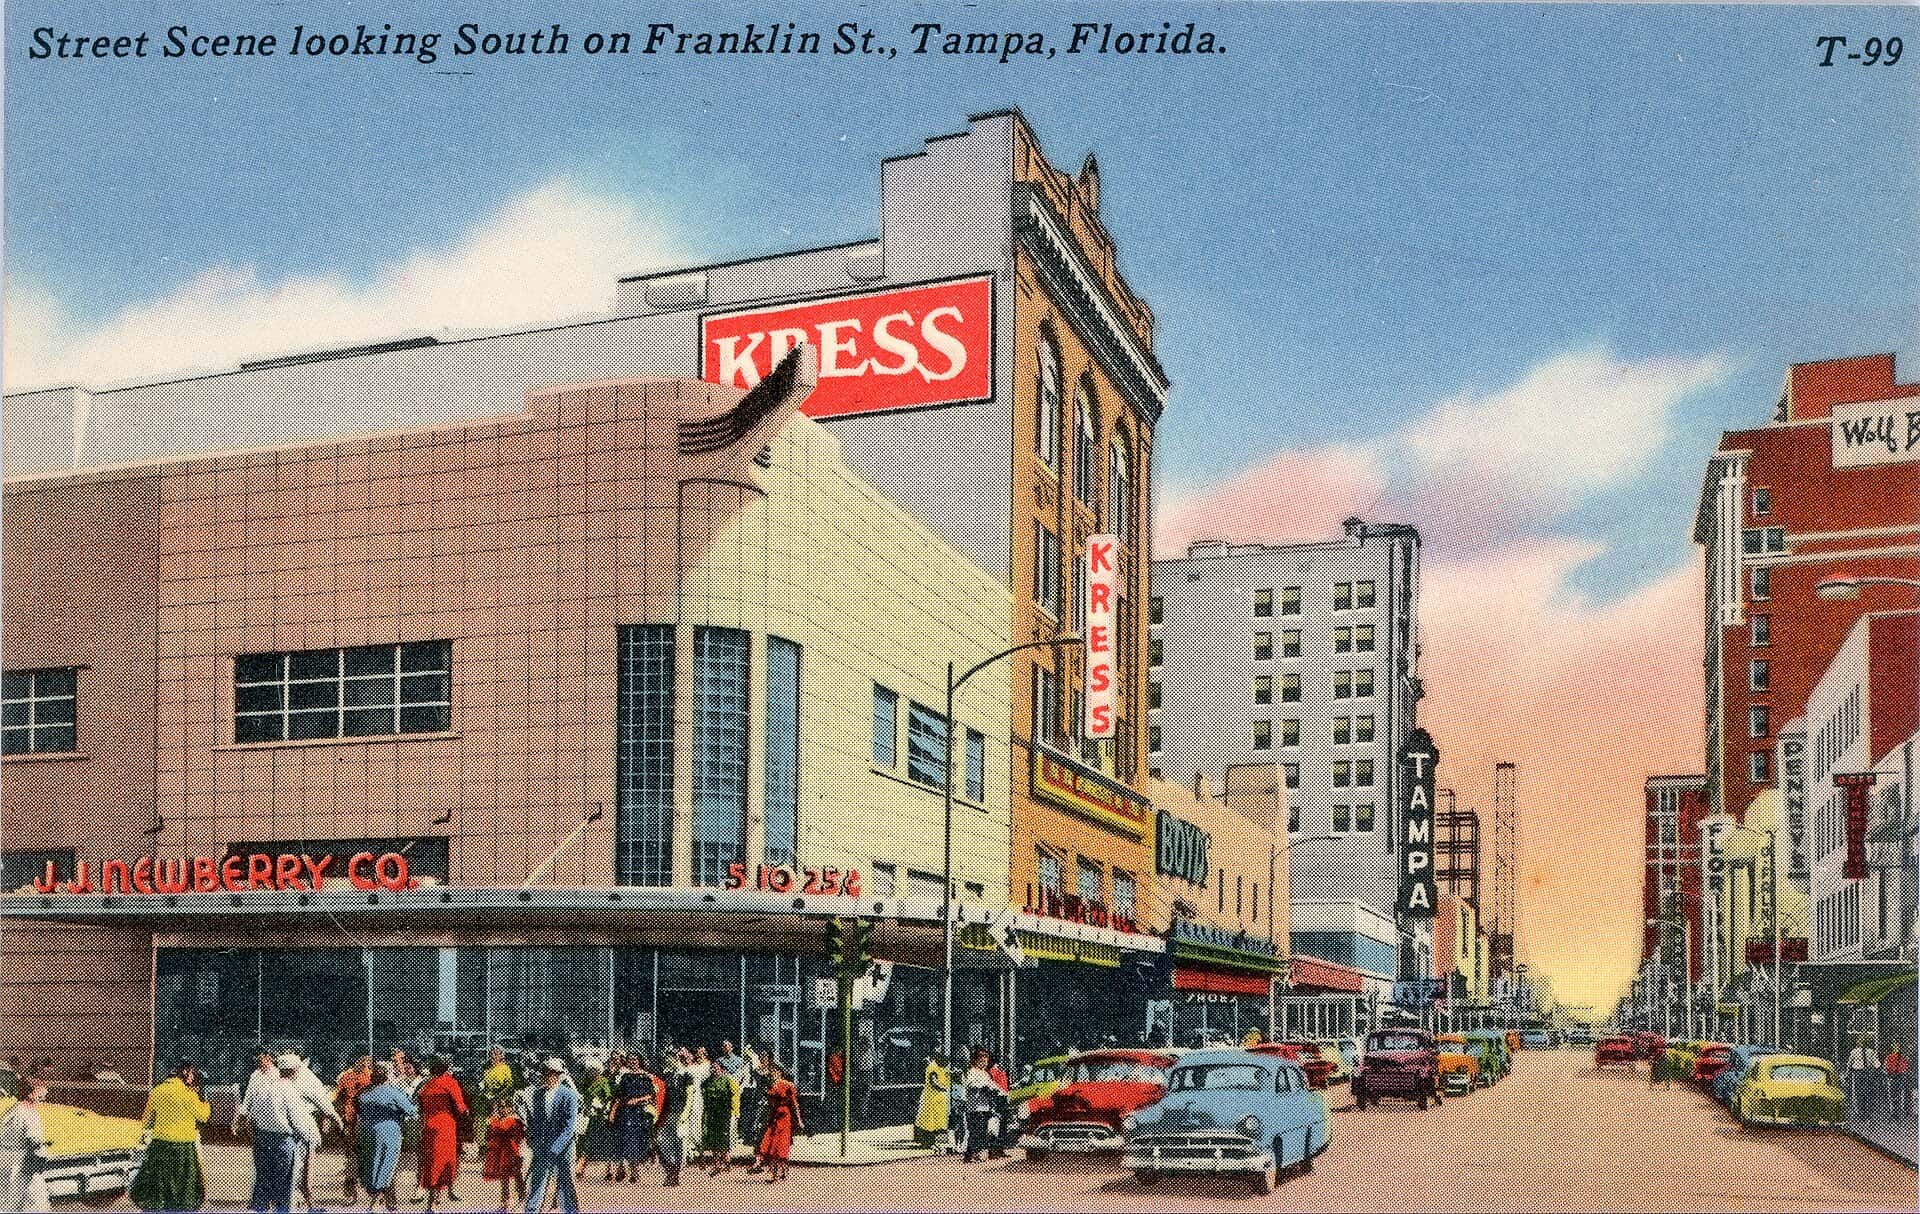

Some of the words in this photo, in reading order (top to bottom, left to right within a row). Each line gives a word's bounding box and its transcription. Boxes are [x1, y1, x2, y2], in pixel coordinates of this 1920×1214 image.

[1840, 415, 1898, 453] Wolf
[1090, 542, 1113, 734] KRESS
[1407, 752, 1431, 909] TAMPA
[102, 853, 333, 894] NEWBERRY
[348, 851, 421, 892] CO.
[725, 863, 747, 892] 5
